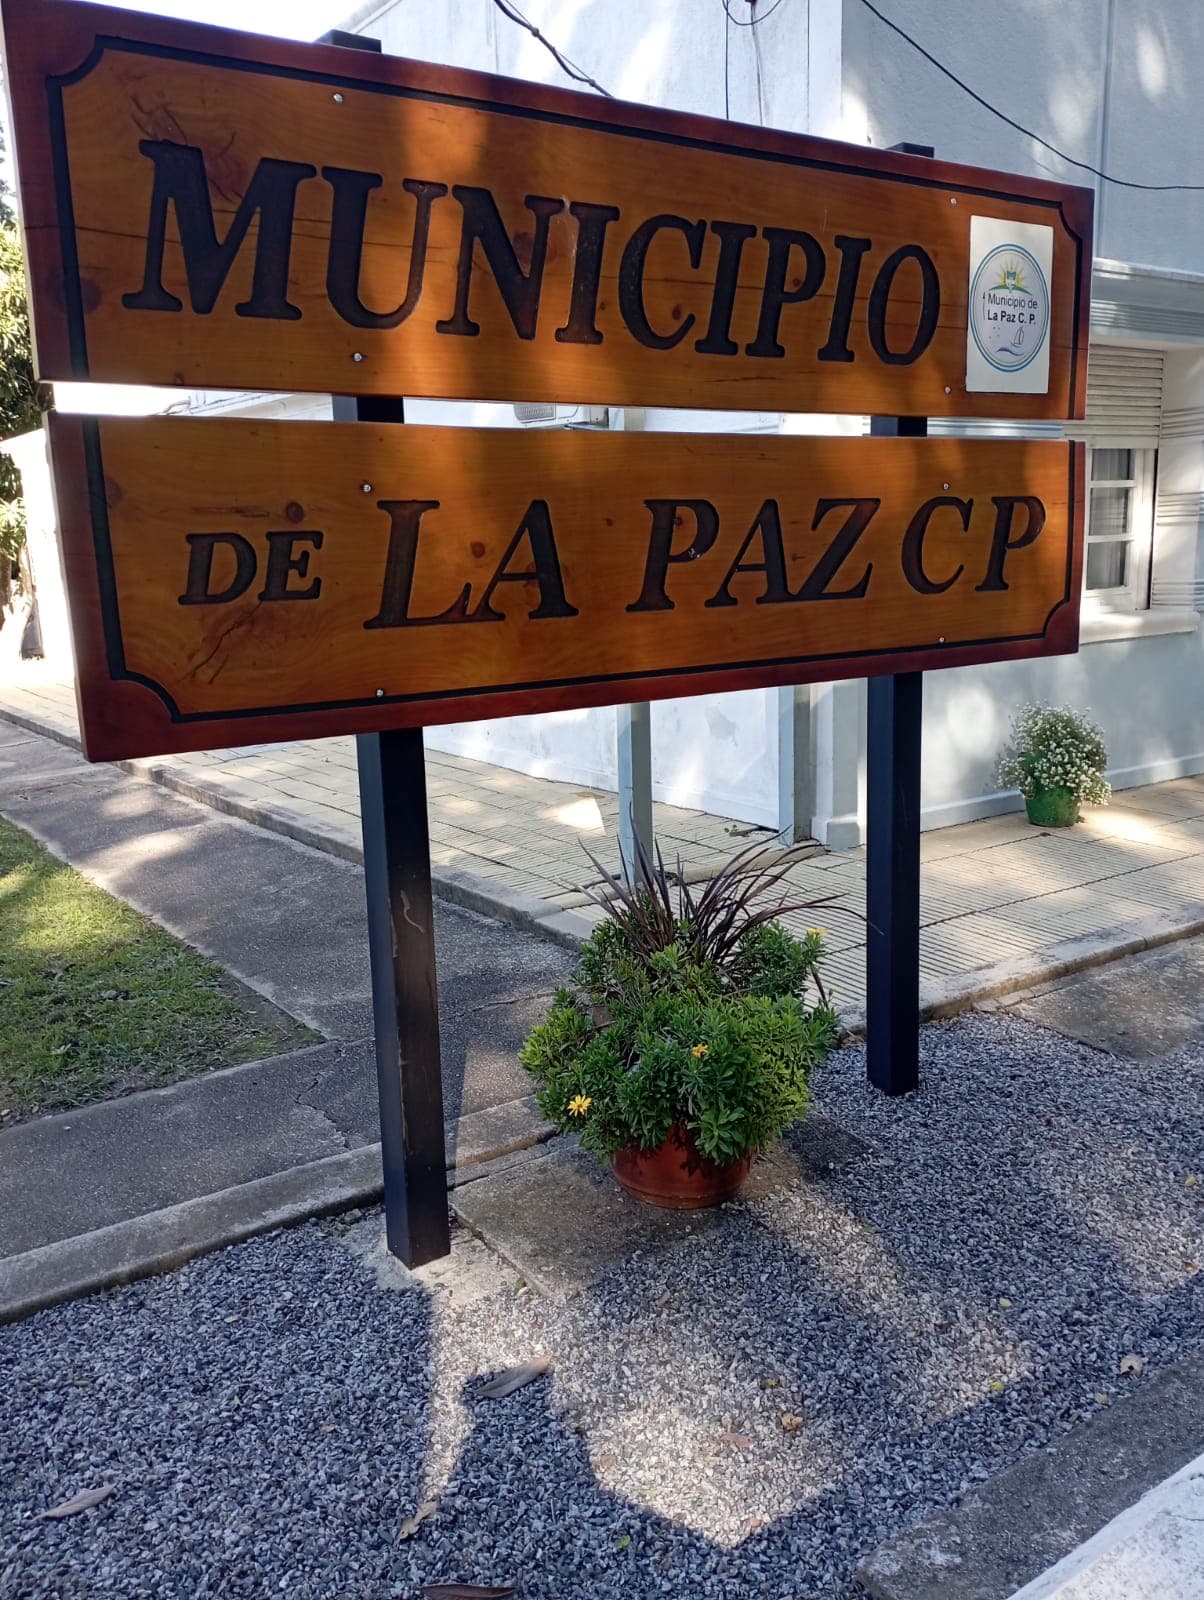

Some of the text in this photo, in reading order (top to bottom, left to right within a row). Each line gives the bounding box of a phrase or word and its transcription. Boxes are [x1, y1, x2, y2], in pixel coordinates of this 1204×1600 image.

[121, 139, 941, 366] MUNICIPIO
[987, 309, 1036, 325] La Paz C. P.
[988, 293, 1038, 309] Municipio de
[177, 495, 1046, 630] DE LA PAZ CP
